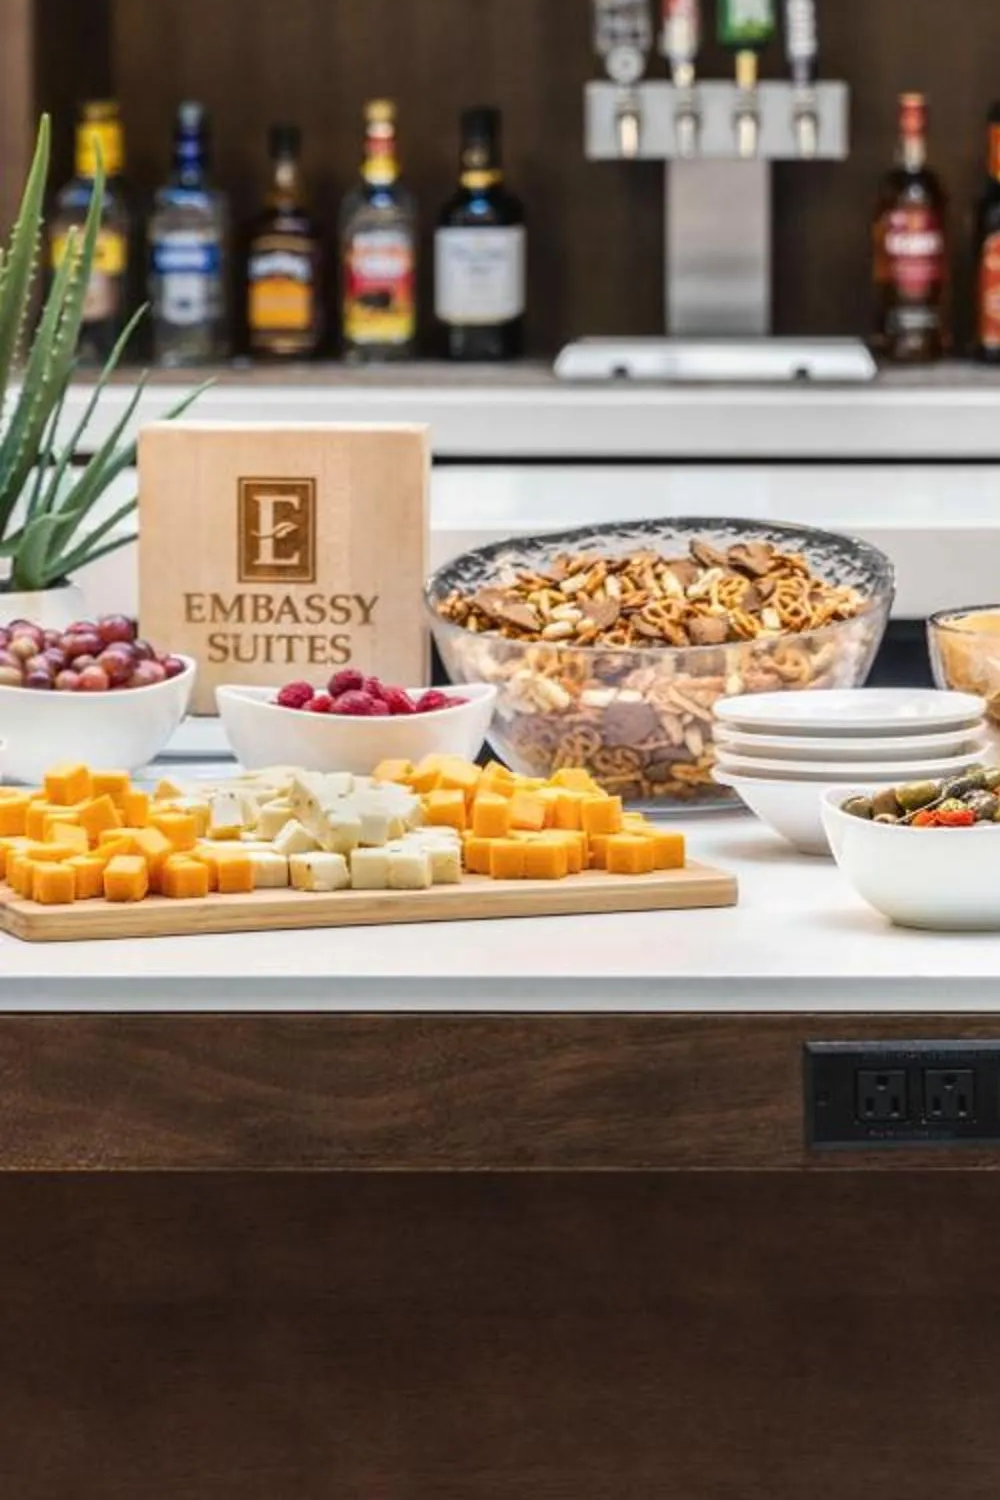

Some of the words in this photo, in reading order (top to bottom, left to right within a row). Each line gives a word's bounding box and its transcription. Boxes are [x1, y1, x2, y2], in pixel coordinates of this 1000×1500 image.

[252, 495, 300, 566] E
[184, 593, 379, 626] EMBASSY
[207, 633, 352, 665] SUITES
